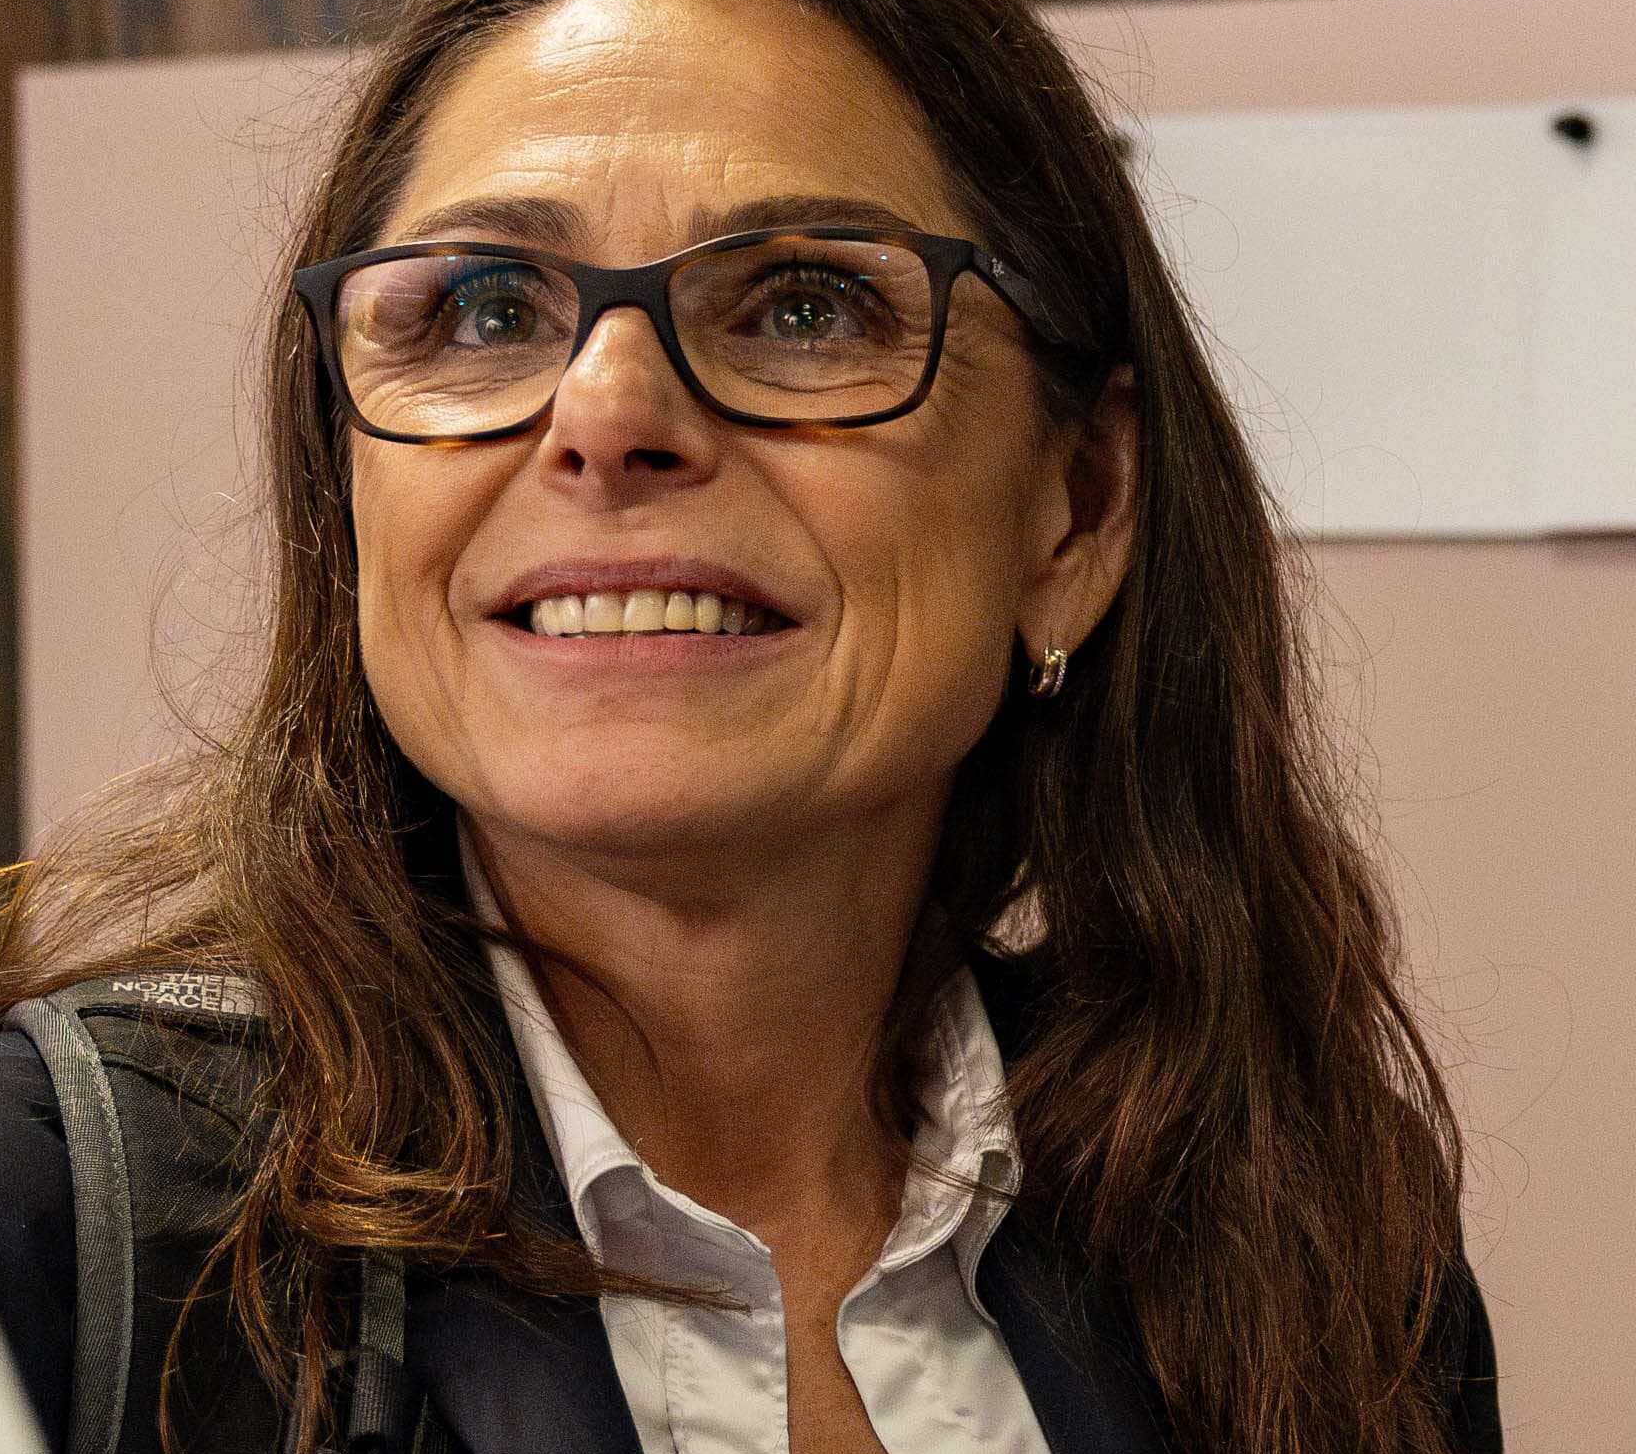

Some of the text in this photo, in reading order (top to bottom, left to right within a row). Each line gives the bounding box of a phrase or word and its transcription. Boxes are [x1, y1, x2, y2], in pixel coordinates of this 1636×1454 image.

[162, 973, 223, 984] THE
[112, 981, 222, 997] NORTH
[143, 991, 221, 1011] FACE
